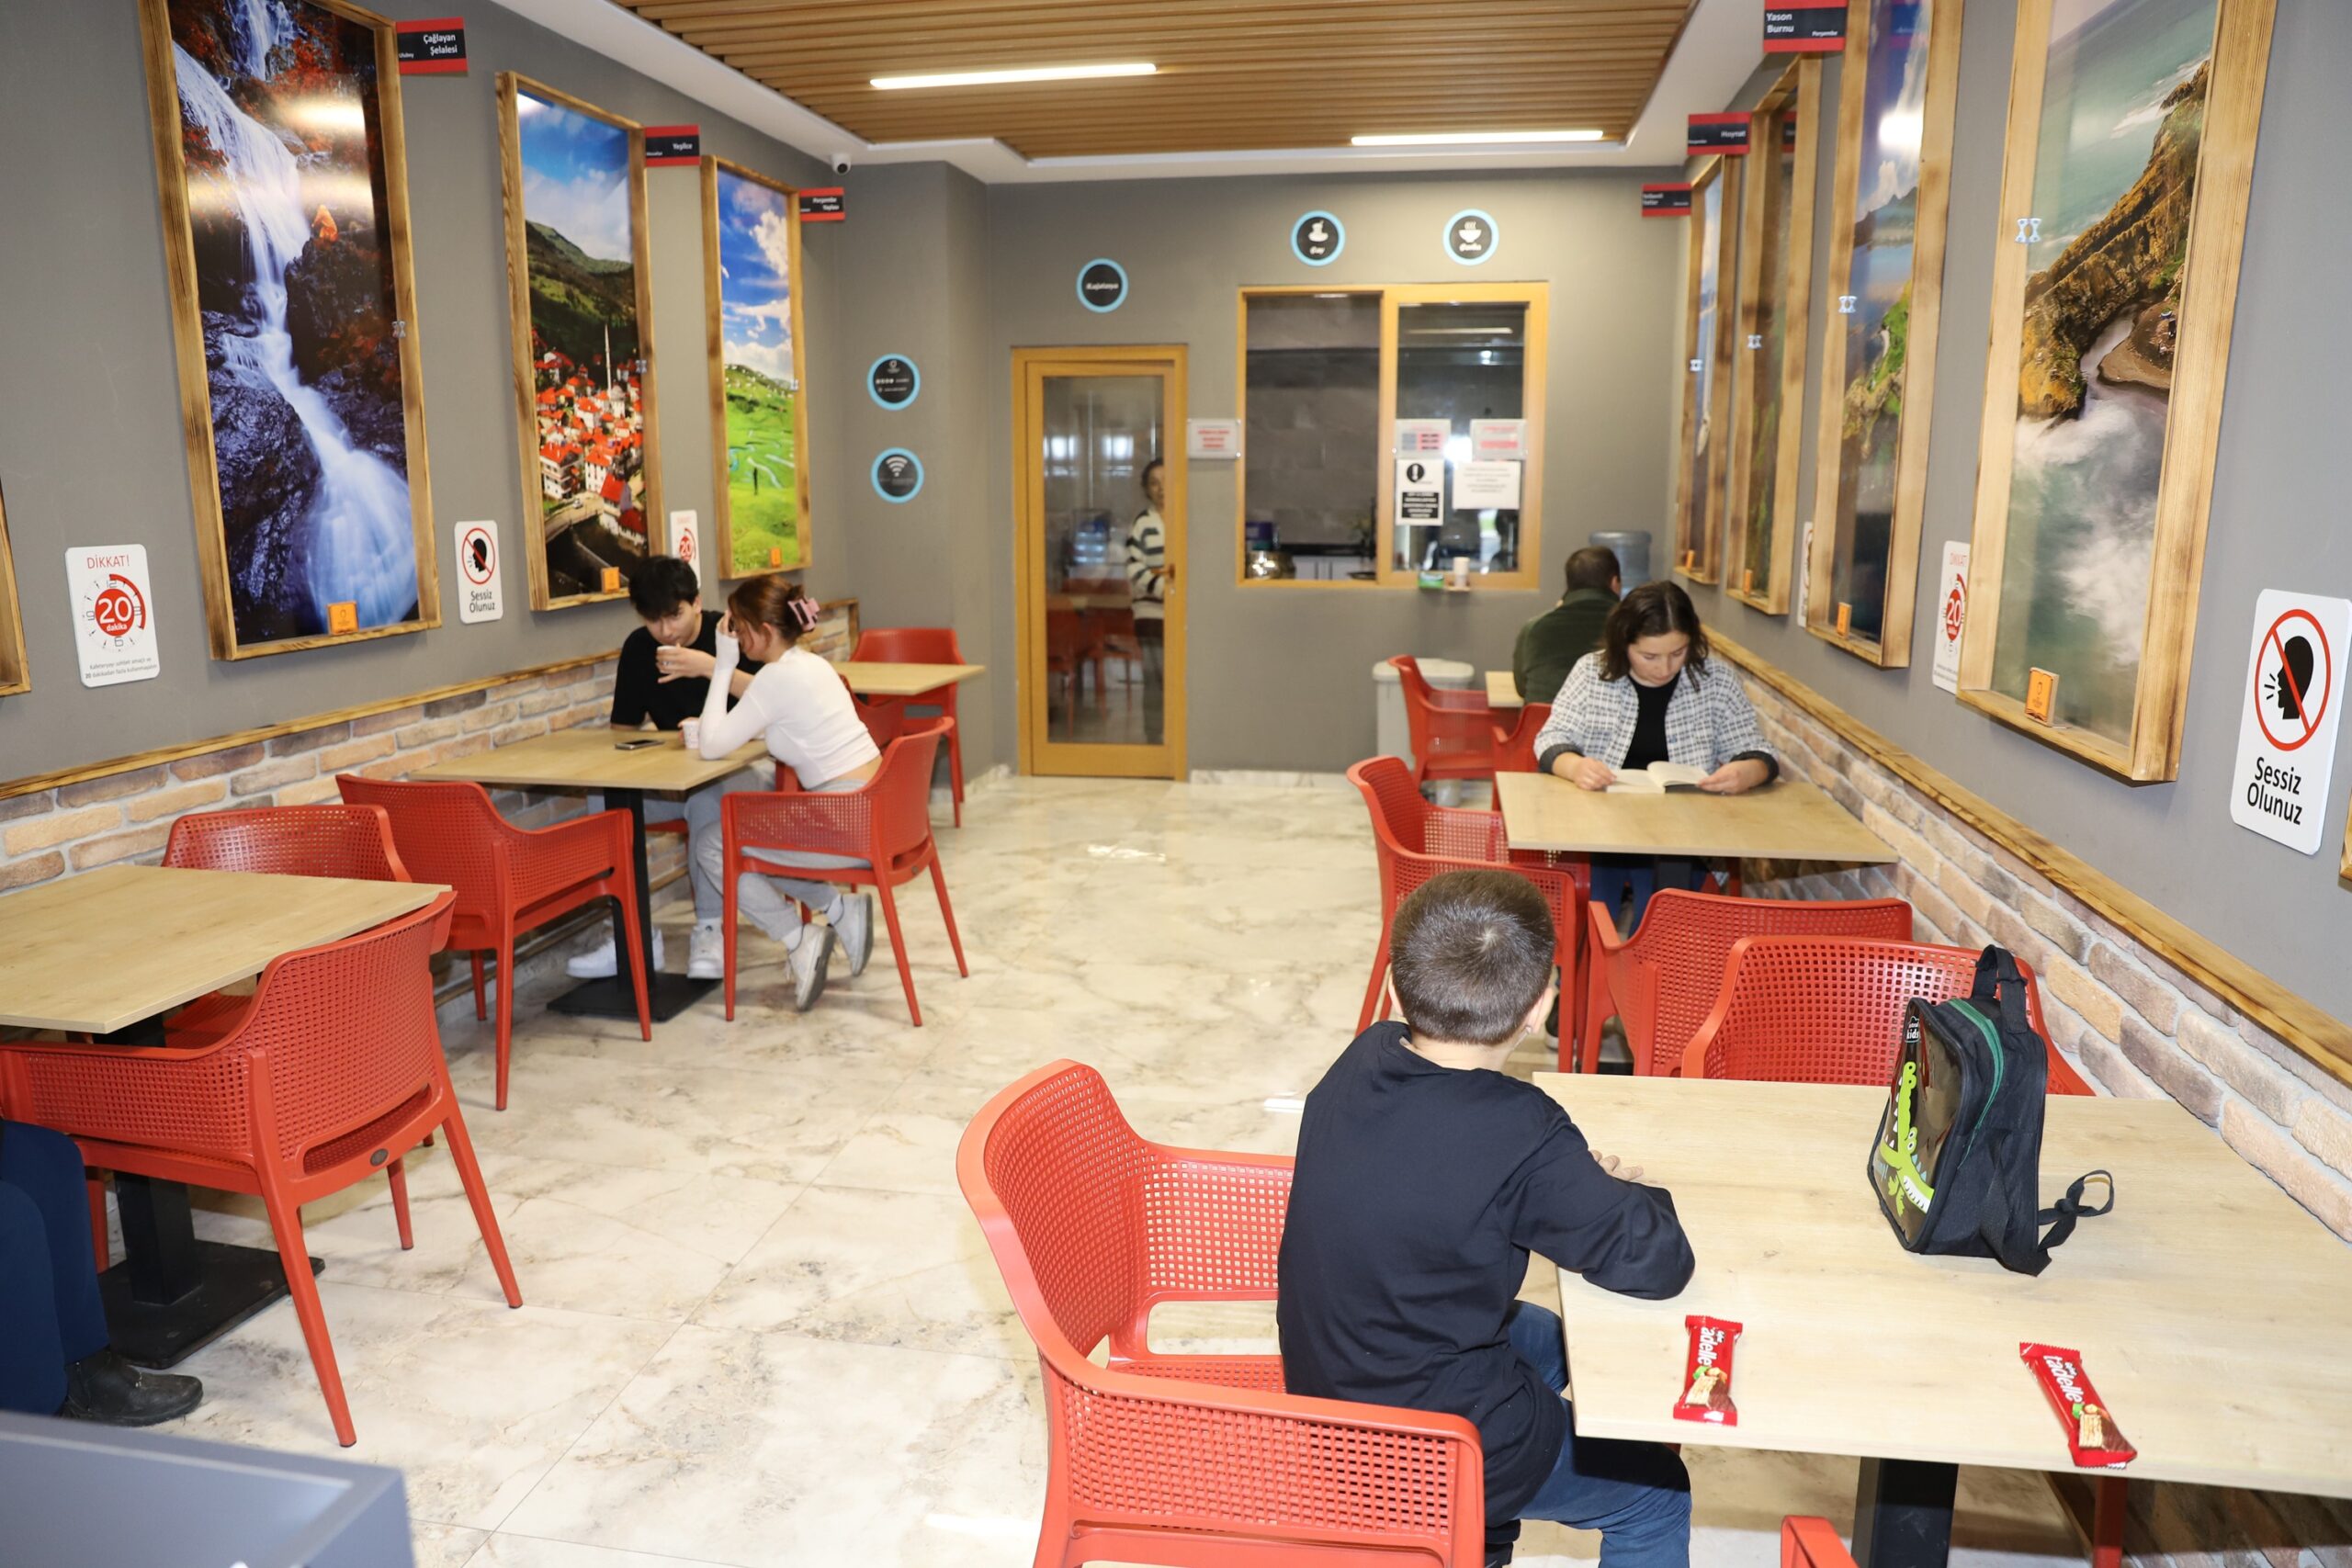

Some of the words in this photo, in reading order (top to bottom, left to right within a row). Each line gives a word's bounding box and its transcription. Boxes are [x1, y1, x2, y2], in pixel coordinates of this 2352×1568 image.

[1766, 13, 1792, 21] Yason
[1767, 25, 1794, 33] Burnu
[423, 33, 456, 44] Çağlayan
[429, 44, 458, 56] Şelalesi
[86, 555, 130, 570] DİKKAT!
[470, 589, 492, 602] Sessiz
[97, 596, 132, 625] 20
[469, 602, 495, 614] Olunuz
[1947, 598, 1962, 627] 20
[106, 623, 128, 632] dakika
[2255, 756, 2301, 795] Sessiz
[2247, 782, 2302, 826] Olunuz
